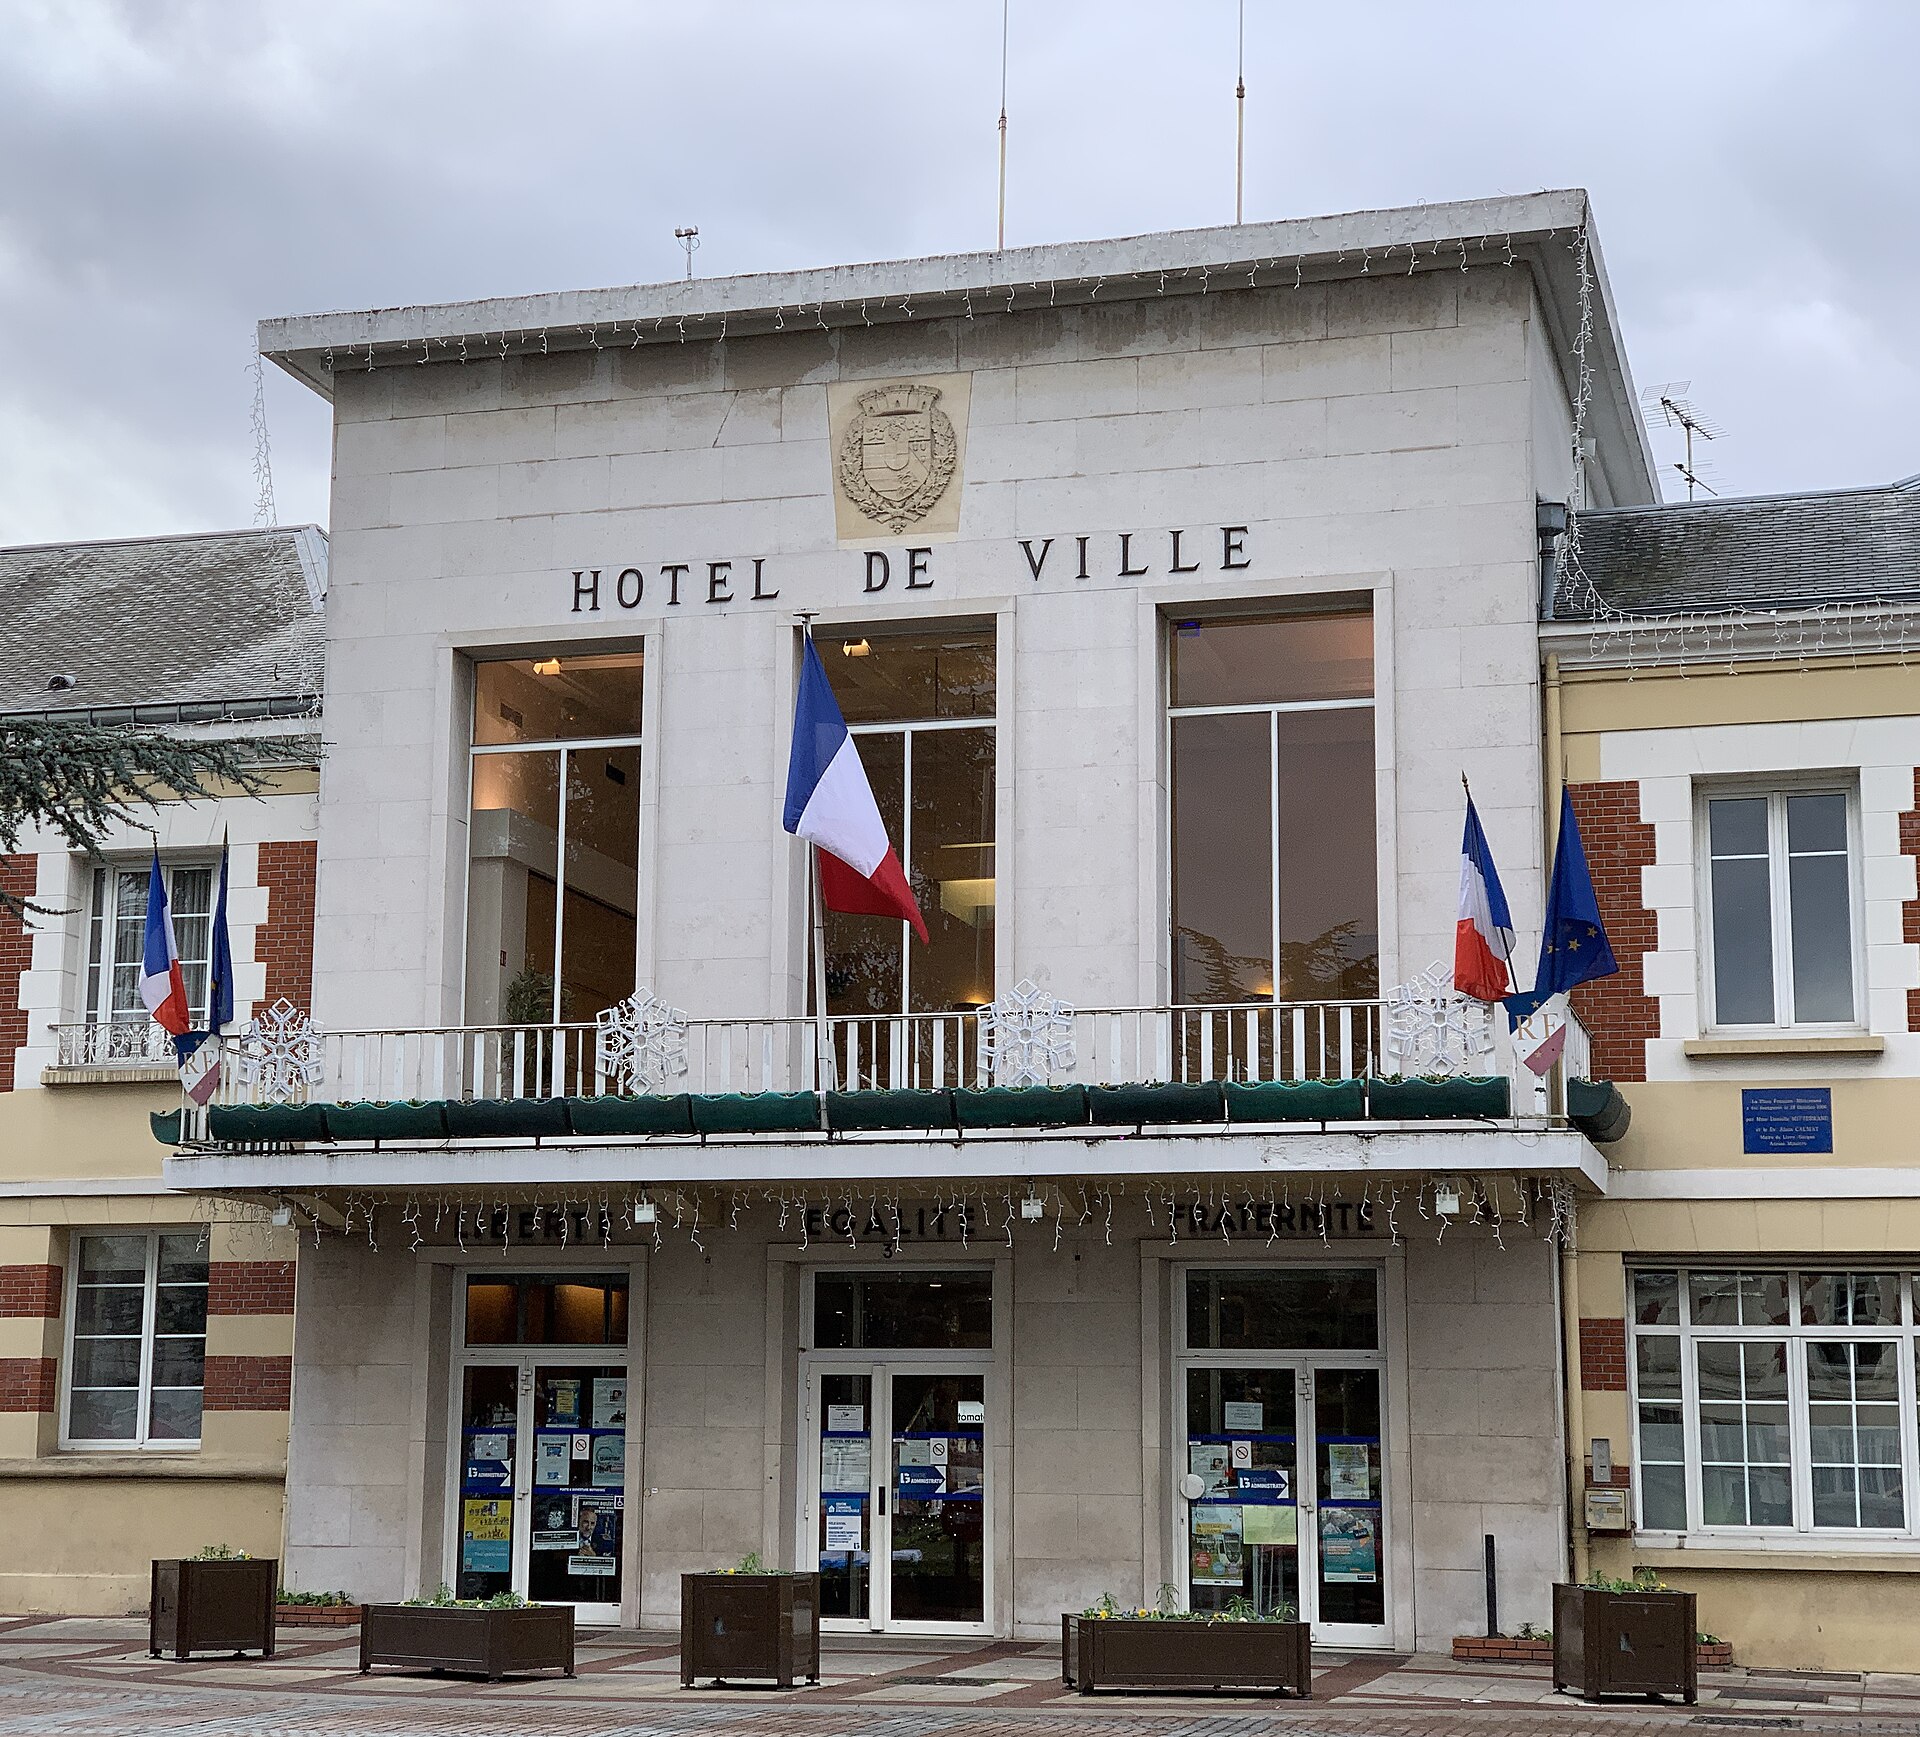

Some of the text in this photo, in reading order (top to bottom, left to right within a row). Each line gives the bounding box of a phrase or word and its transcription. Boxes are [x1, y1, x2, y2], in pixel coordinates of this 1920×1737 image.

[571, 525, 1252, 612] HOTEL DE VILLE
[883, 1243, 892, 1258] 3
